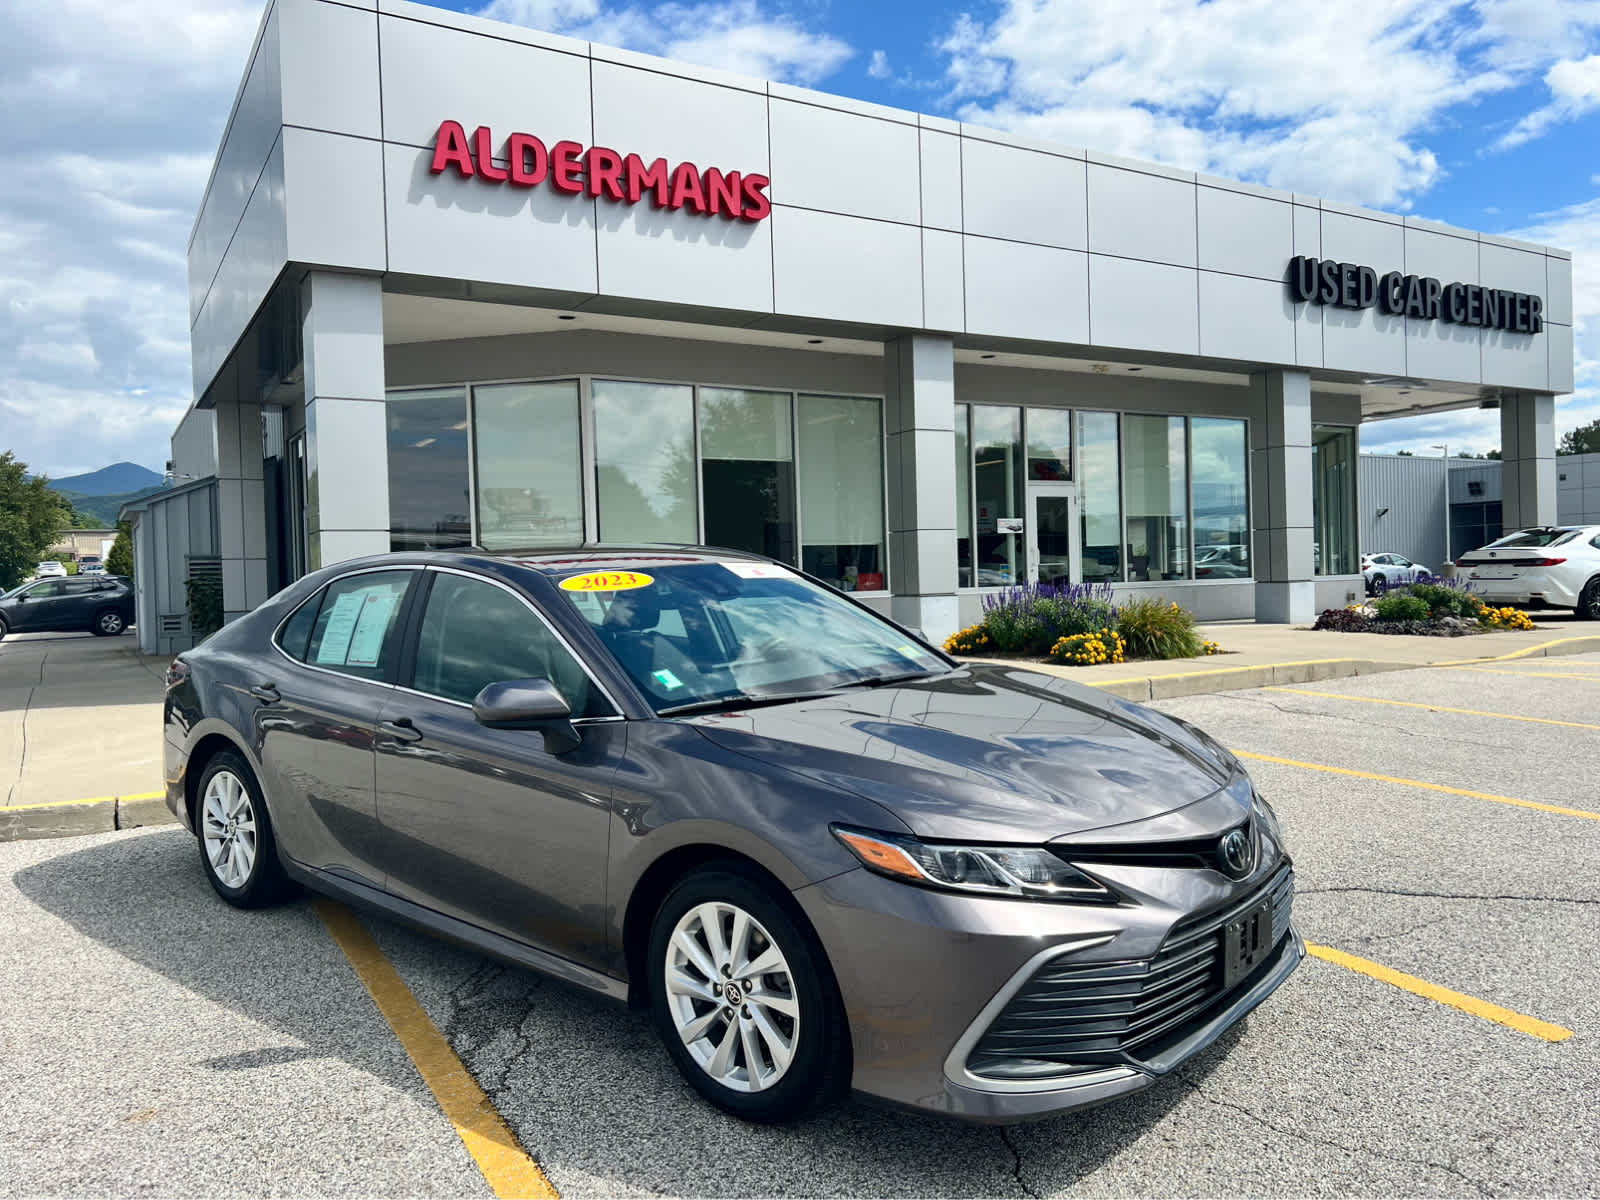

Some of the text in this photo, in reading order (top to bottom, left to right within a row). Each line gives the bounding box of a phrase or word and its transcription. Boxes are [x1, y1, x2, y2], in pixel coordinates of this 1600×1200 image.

[430, 119, 771, 221] ALDERMANS
[1291, 255, 1544, 334] USED CAR CENTER
[581, 573, 637, 589] 2023
